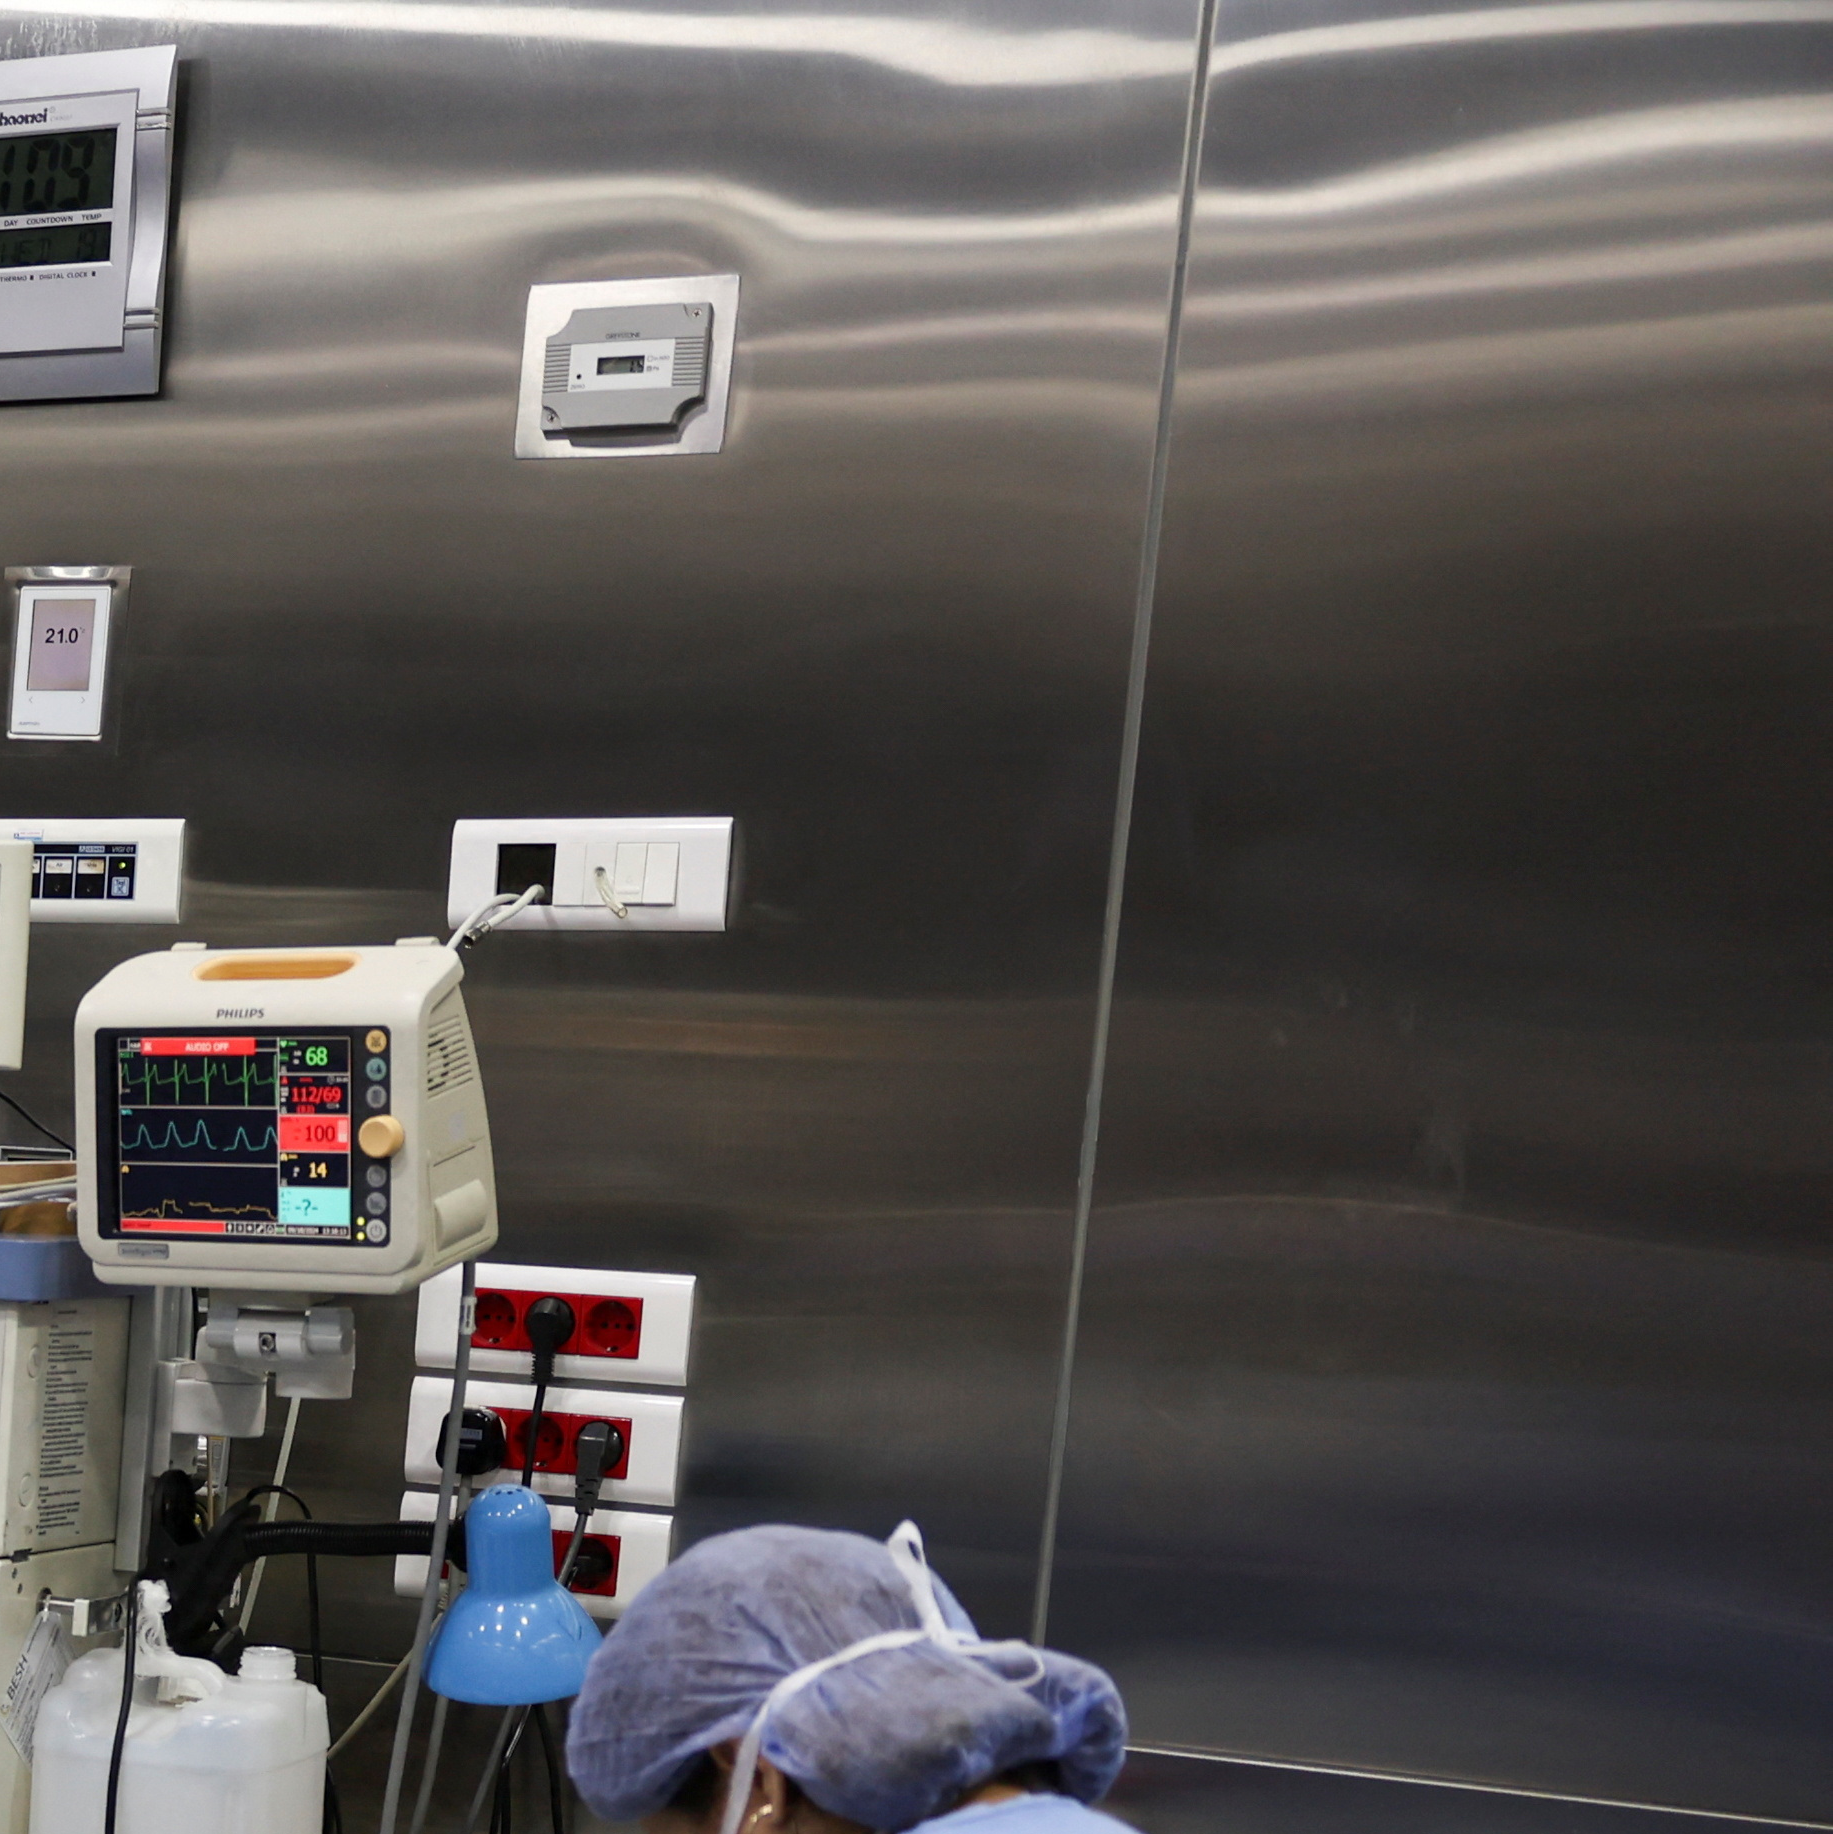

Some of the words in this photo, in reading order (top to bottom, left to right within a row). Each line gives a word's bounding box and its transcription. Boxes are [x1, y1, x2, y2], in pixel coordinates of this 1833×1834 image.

[4, 219, 19, 227] DAY
[26, 215, 73, 226] COUNTDOWN
[81, 213, 102, 221] TEMP
[0, 275, 27, 283] THERMO
[67, 271, 88, 279] CLOCK
[605, 332, 641, 340] GREYSTONE
[45, 627, 79, 644] 21.0
[217, 1008, 265, 1019] PHILIPS
[185, 1042, 212, 1052] AUDIO
[213, 1042, 230, 1051] OFF
[305, 1047, 328, 1066] 68
[291, 1087, 342, 1103] 112/69
[306, 1126, 335, 1141] 100
[309, 1163, 327, 1178] 14
